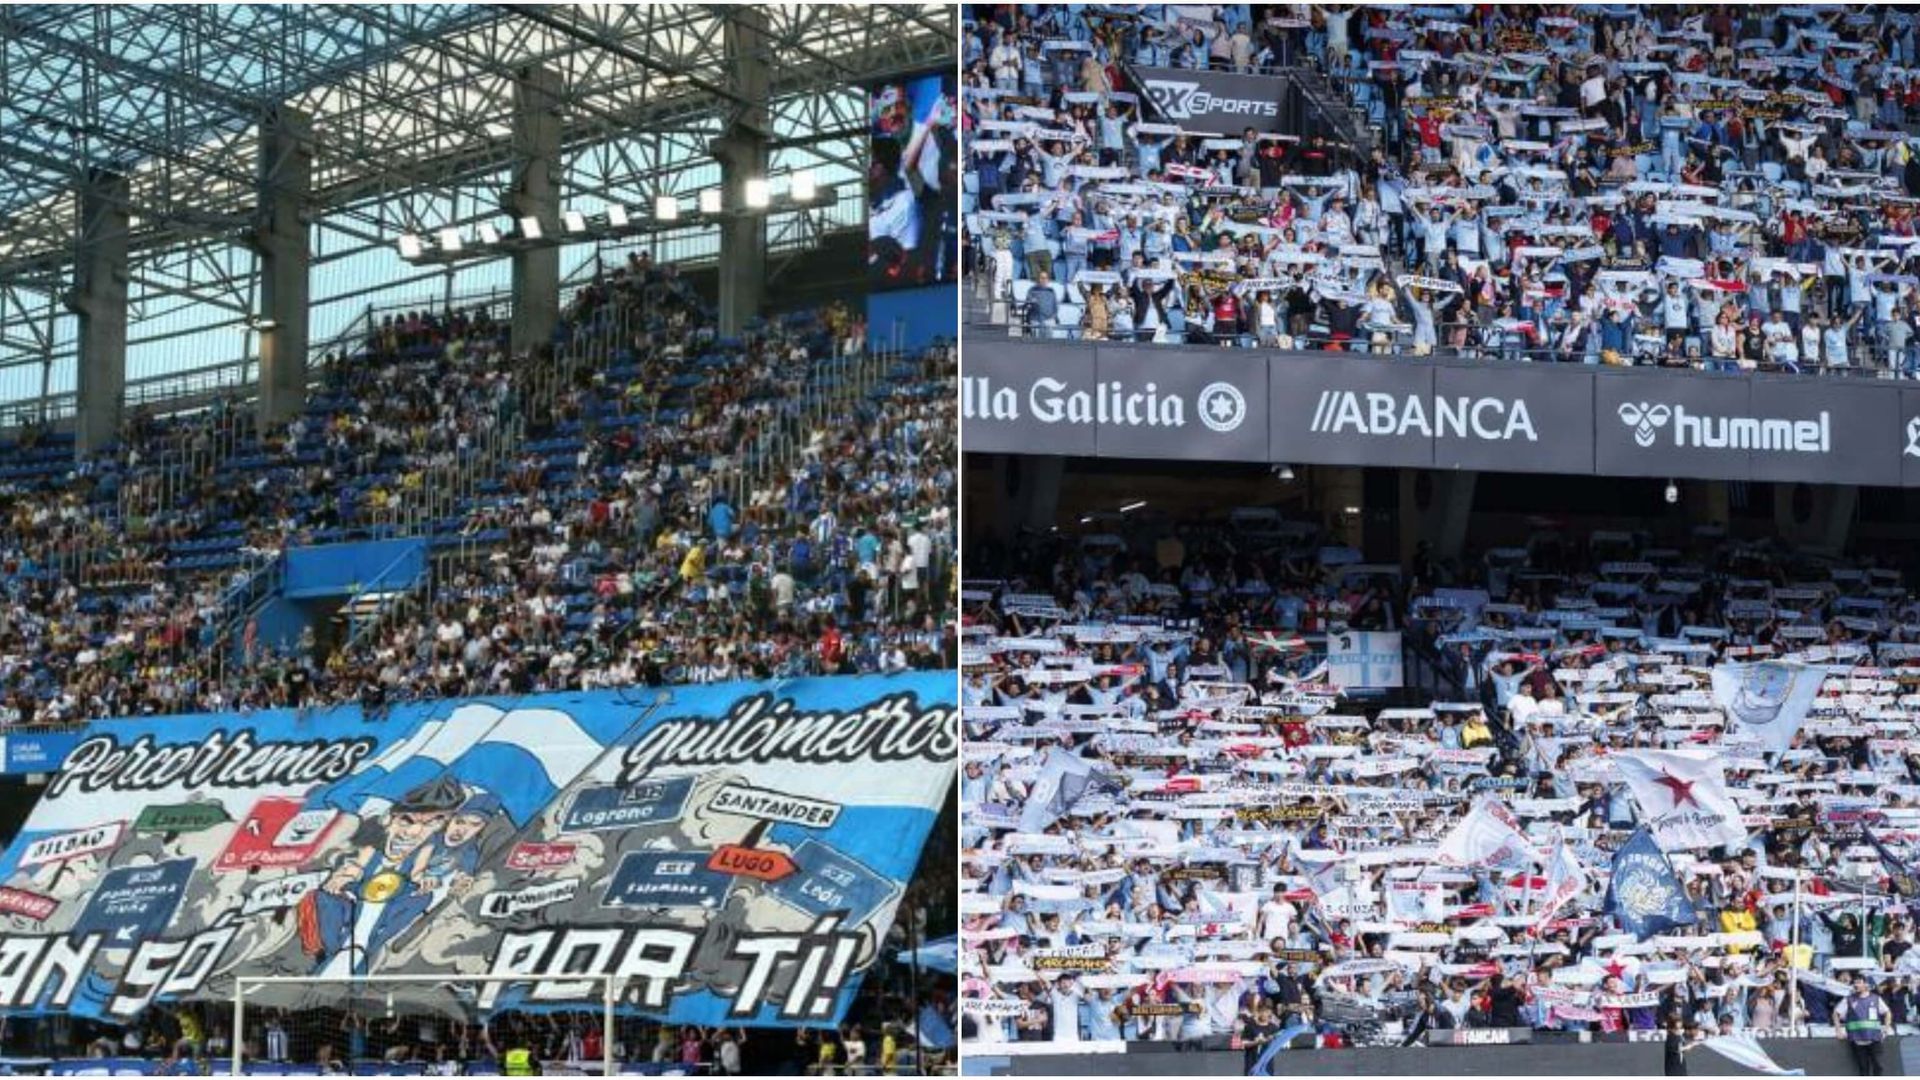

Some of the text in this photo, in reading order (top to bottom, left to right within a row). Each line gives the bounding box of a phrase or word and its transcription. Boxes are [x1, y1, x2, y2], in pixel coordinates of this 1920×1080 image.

[1029, 377, 1188, 427] Galicia
[1674, 404, 1831, 452] hummel
[50, 731, 371, 796] Percorremos
[717, 792, 834, 824] SANTANDER
[719, 850, 775, 873] LUGO
[800, 879, 844, 907] León
[109, 910, 240, 1016] SÓ
[476, 927, 697, 1009] POR
